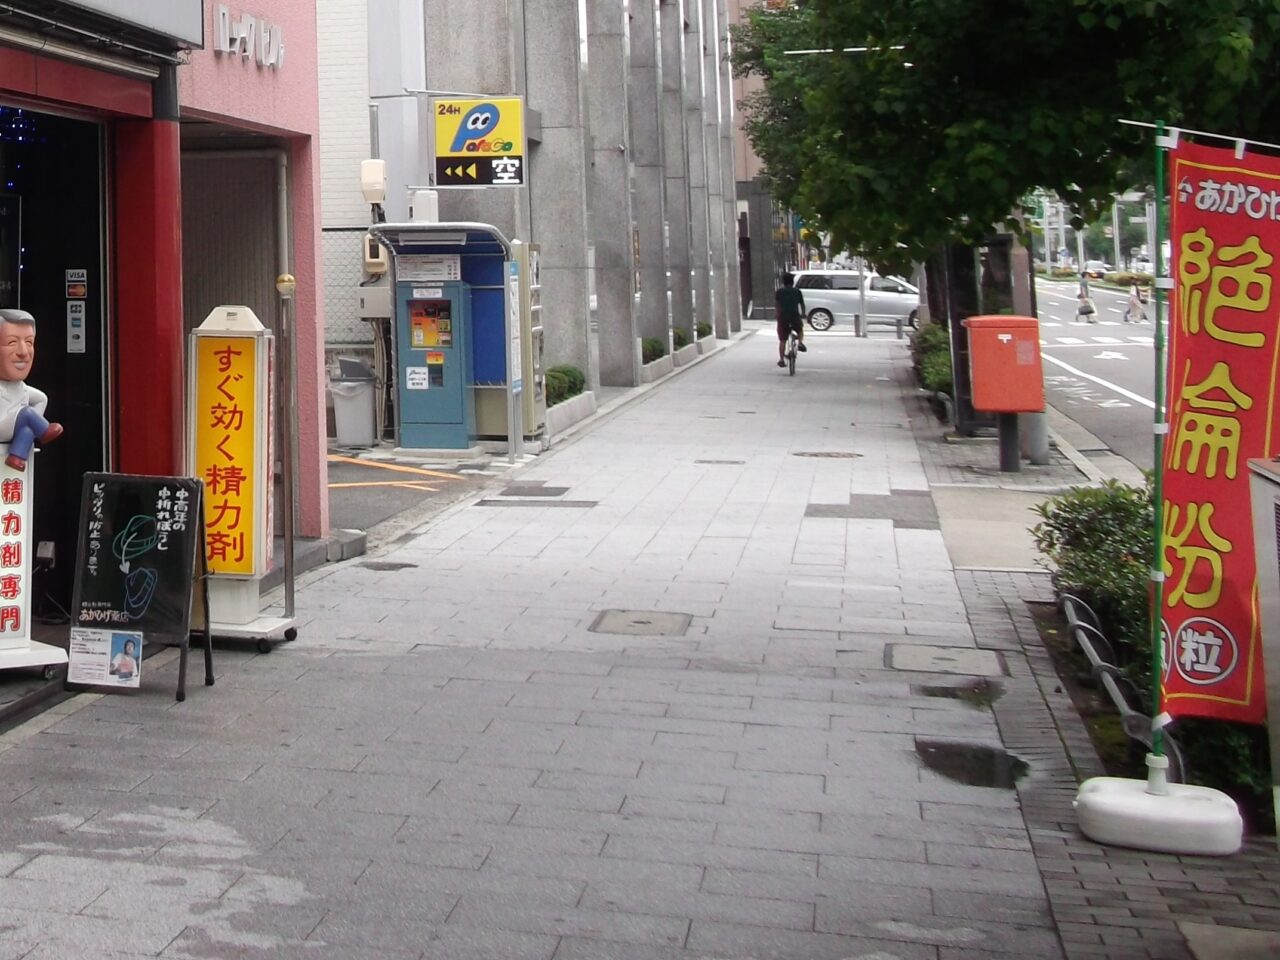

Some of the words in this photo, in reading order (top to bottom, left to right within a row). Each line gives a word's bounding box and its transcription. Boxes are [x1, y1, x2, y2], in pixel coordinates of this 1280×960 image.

[438, 104, 461, 116] 24H
[491, 156, 520, 184] 空
[205, 345, 248, 563] すぐ効く精力剤
[1161, 227, 1275, 612] 絶倫粉
[0, 478, 24, 633] 精力剤専門
